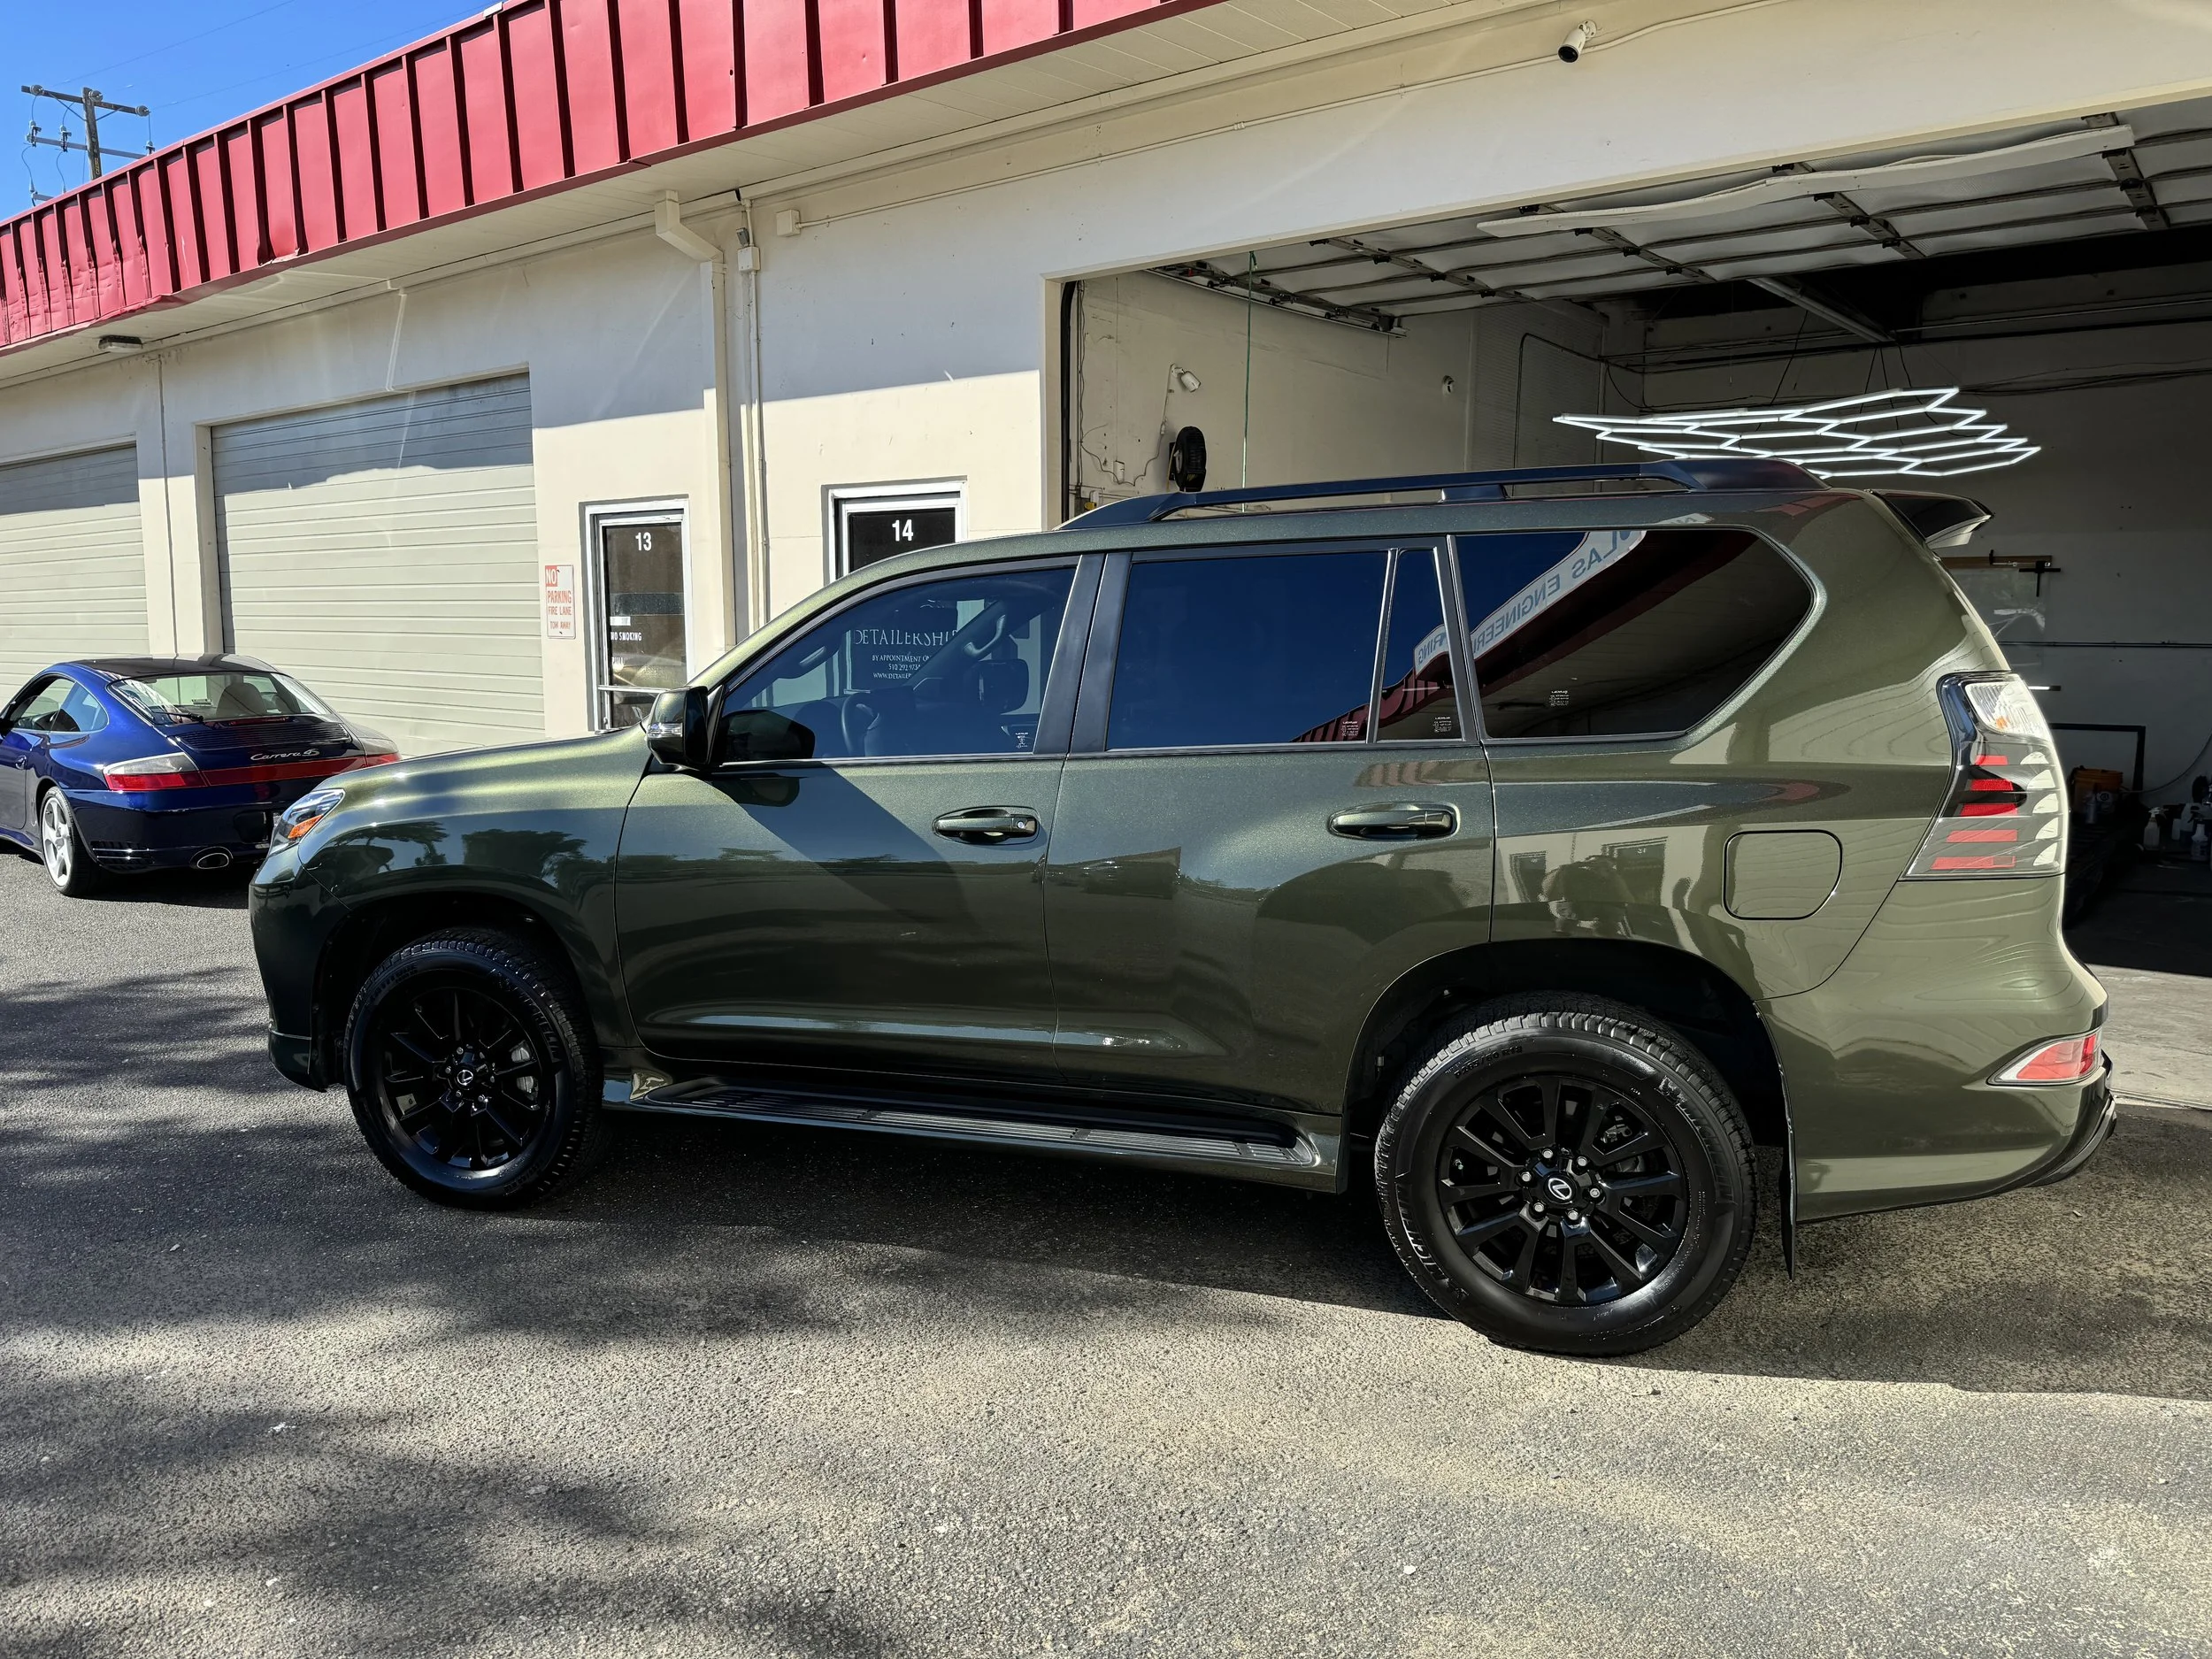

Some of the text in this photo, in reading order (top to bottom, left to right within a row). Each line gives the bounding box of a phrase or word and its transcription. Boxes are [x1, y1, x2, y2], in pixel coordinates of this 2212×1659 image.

[892, 519, 914, 541] 14
[634, 532, 652, 551] 13
[545, 568, 557, 585] NO
[547, 590, 572, 603] PARKING
[548, 606, 572, 616] FIRE LANE
[549, 620, 571, 630] TOW AWAY
[611, 631, 642, 641] NO SMOKING
[879, 654, 921, 663] APPOINTMENT
[250, 752, 301, 761] Carrera
